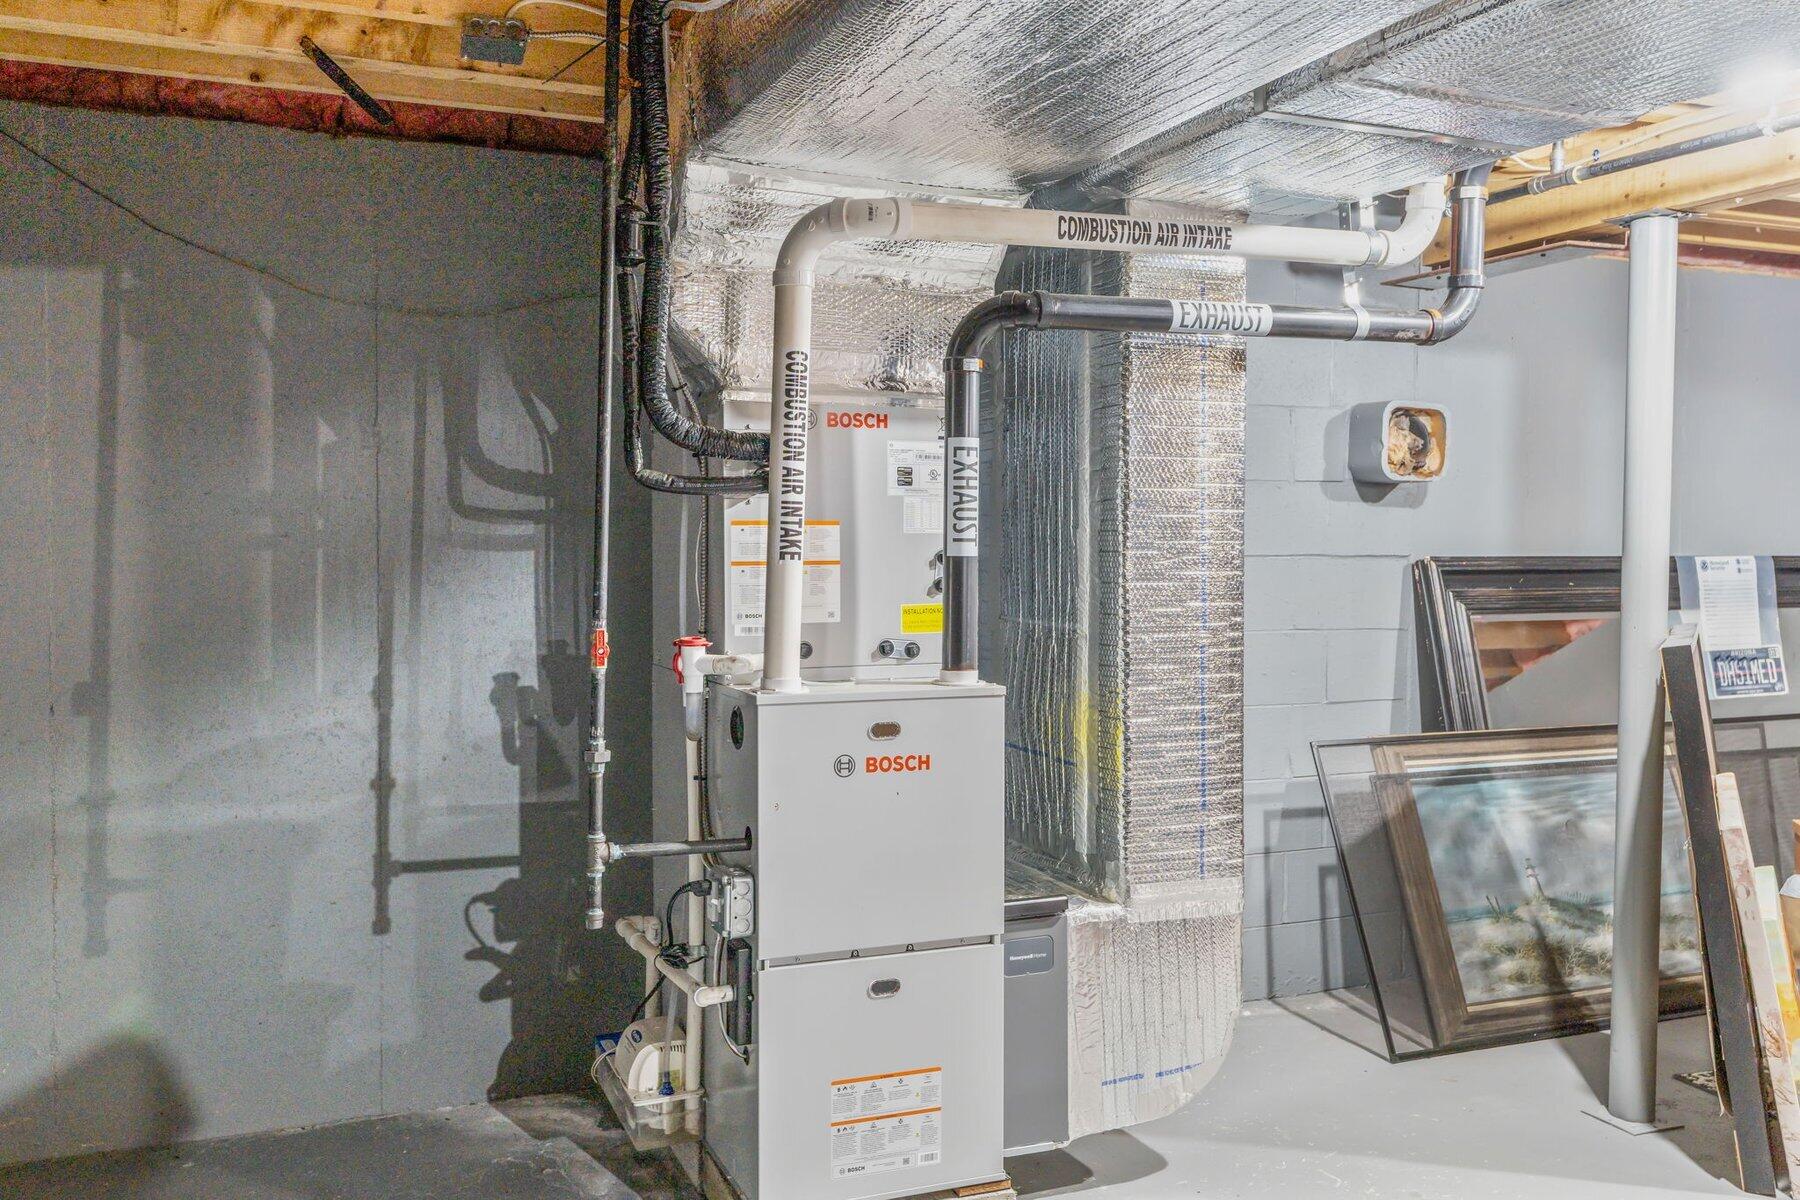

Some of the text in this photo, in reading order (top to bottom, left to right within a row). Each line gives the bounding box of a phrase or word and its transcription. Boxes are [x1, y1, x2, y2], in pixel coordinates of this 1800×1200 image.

[1057, 215, 1232, 250] COMBUSTION AIR INTAKE
[1178, 302, 1264, 332] EXHAUST
[826, 412, 888, 429] BOSCH
[779, 350, 809, 561] COMBUSTION AIR INTAKE
[952, 446, 979, 547] EXHAUST
[865, 754, 931, 773] BOSCH
[847, 1165, 865, 1173] BOSCH
